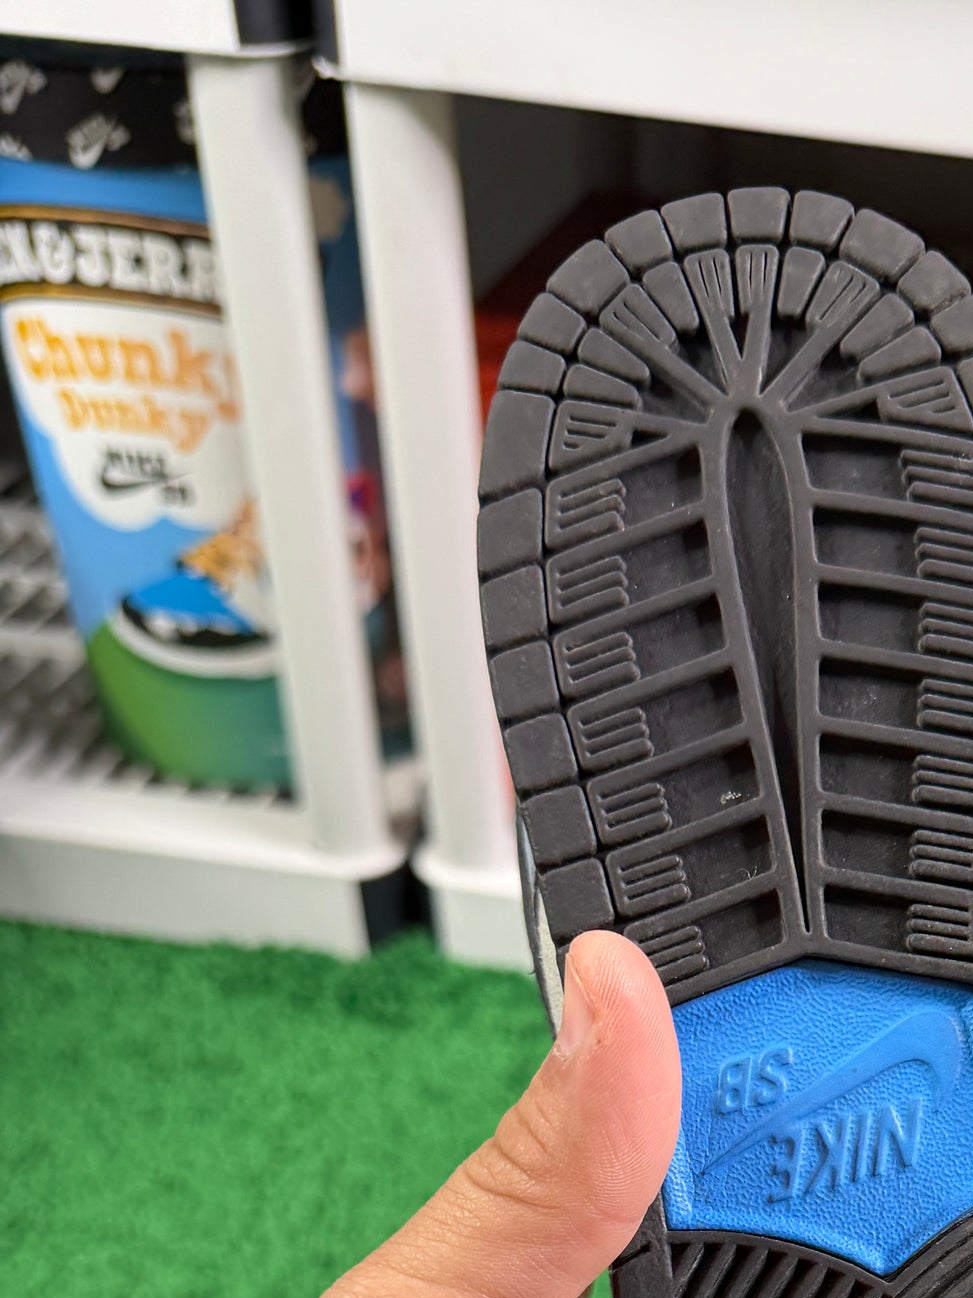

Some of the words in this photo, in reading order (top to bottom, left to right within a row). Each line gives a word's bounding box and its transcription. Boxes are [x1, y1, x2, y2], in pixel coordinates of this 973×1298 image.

[58, 388, 213, 455] Dunky
[715, 1046, 795, 1116] SB
[765, 1096, 925, 1206] NIKE
